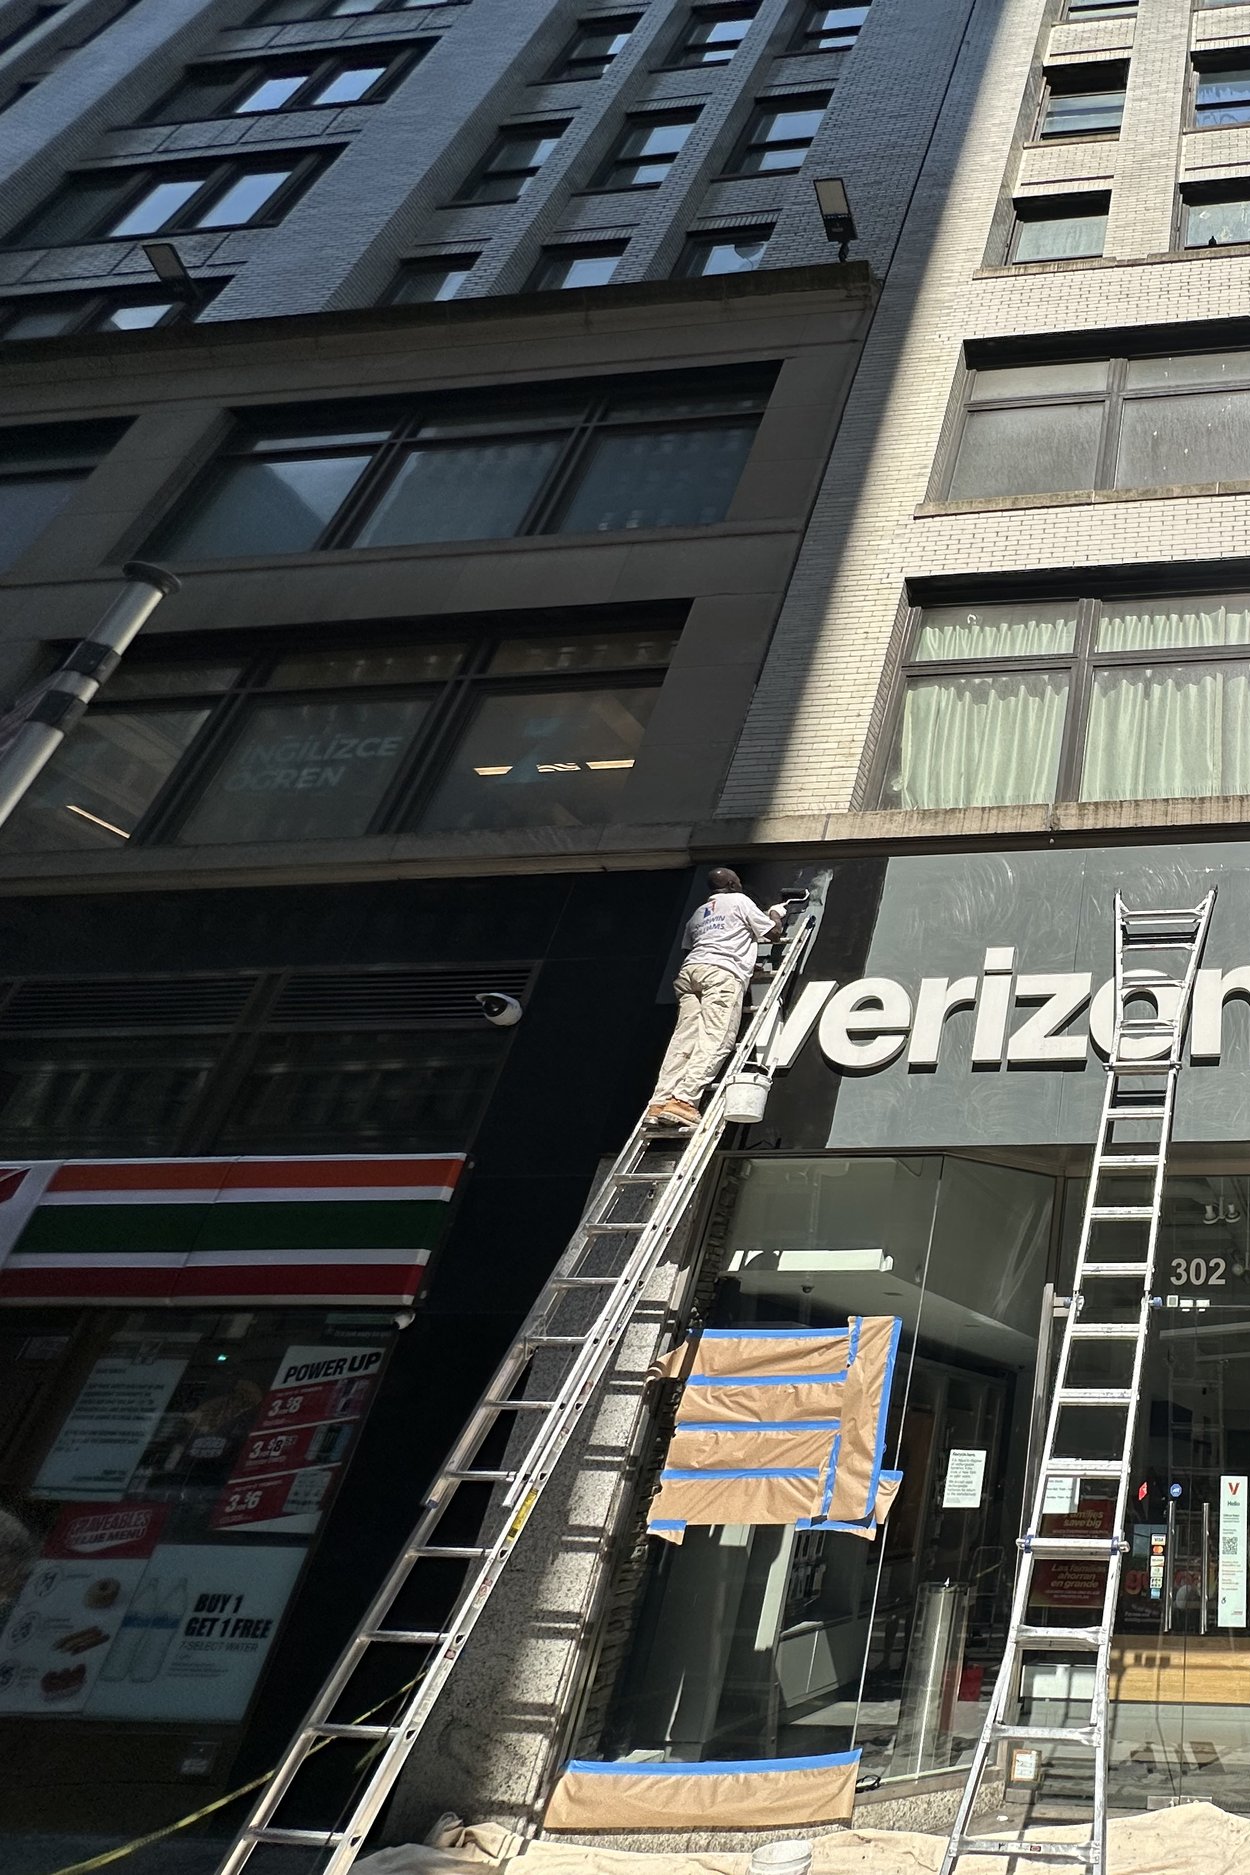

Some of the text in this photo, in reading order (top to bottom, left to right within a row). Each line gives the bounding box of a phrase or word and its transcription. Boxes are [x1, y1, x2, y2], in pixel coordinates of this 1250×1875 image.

[1170, 1258, 1226, 1286] 302
[283, 1351, 382, 1384] POWER UP
[1086, 1519, 1103, 1529] big
[194, 1593, 245, 1614] BUY 1
[184, 1617, 274, 1639] GET 1 FREE
[224, 1642, 258, 1653] WATER
